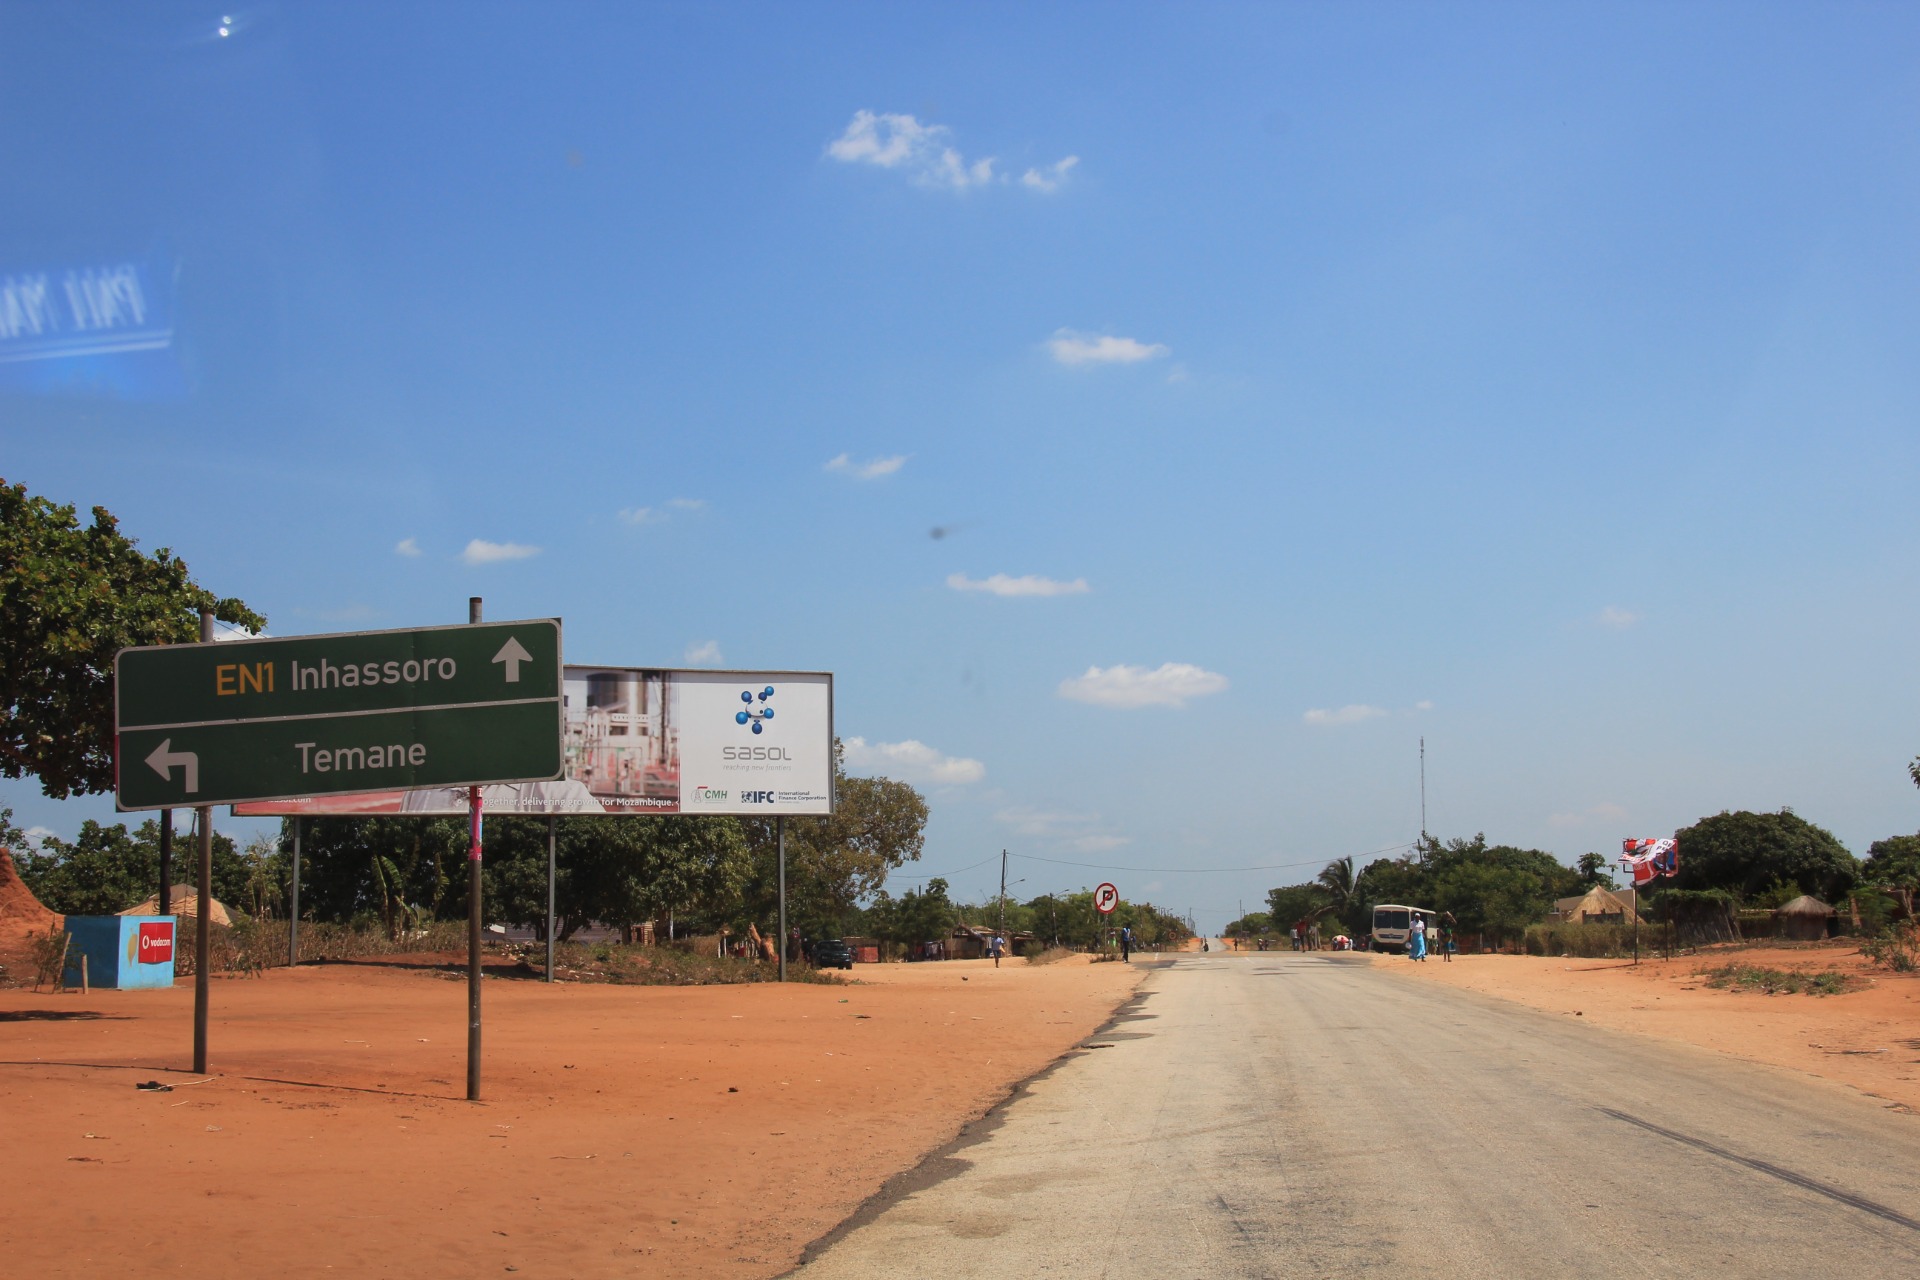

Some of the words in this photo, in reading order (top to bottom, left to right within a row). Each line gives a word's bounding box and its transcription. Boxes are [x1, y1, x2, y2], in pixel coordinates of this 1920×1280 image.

[215, 661, 275, 696] EN1
[291, 656, 457, 691] Inhassoro
[295, 742, 427, 774] Temane
[722, 763, 750, 772] reaching
[766, 764, 792, 772] frontiers
[704, 790, 728, 800] CMH
[753, 790, 775, 804] IFC
[482, 798, 520, 807] ogether,
[522, 797, 565, 808] delivering
[568, 797, 599, 808] growth
[601, 797, 616, 806] for
[616, 797, 674, 809] Mozambique.
[1102, 890, 1114, 906] P
[150, 938, 171, 947] vodacom
